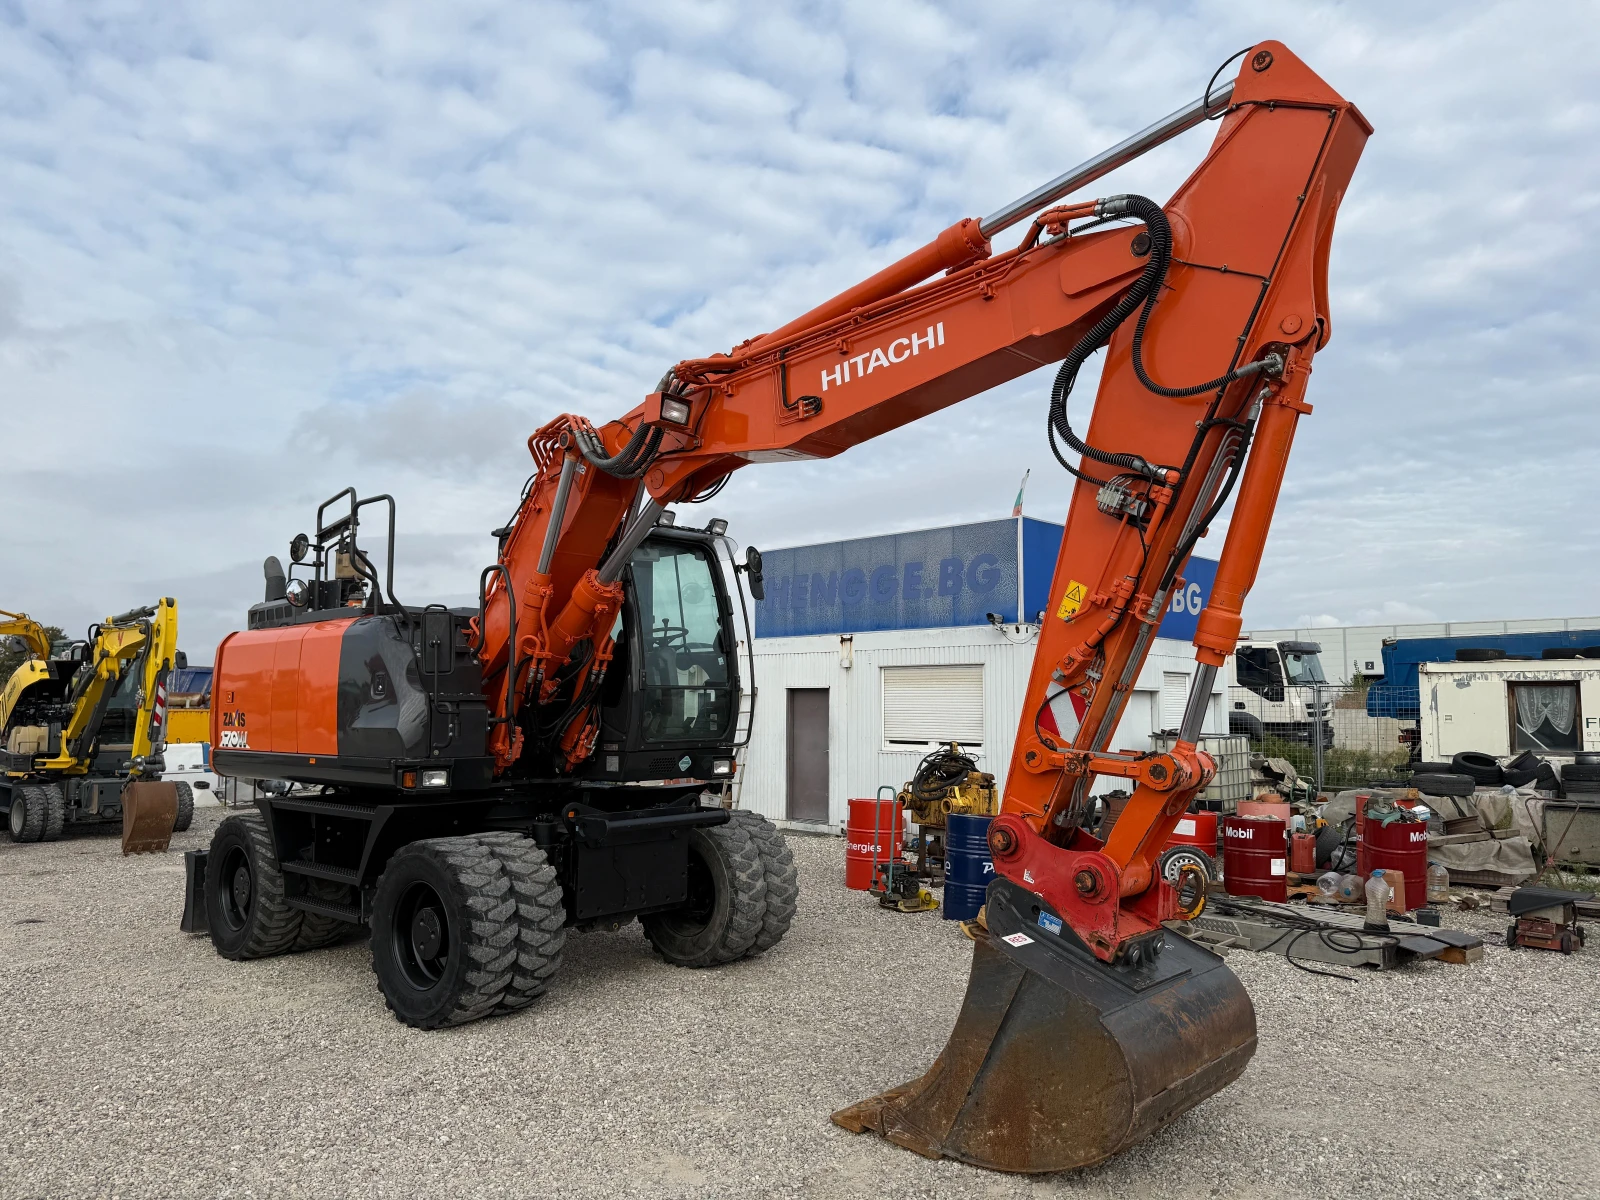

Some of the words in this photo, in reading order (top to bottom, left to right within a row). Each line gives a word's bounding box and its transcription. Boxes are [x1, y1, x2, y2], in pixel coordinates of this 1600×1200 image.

[820, 321, 946, 392] HITACHI
[764, 553, 1000, 609] HENGGE.BG
[223, 709, 246, 727] ZAXIS
[1586, 717, 1600, 729] F
[1225, 826, 1253, 839] Mobil
